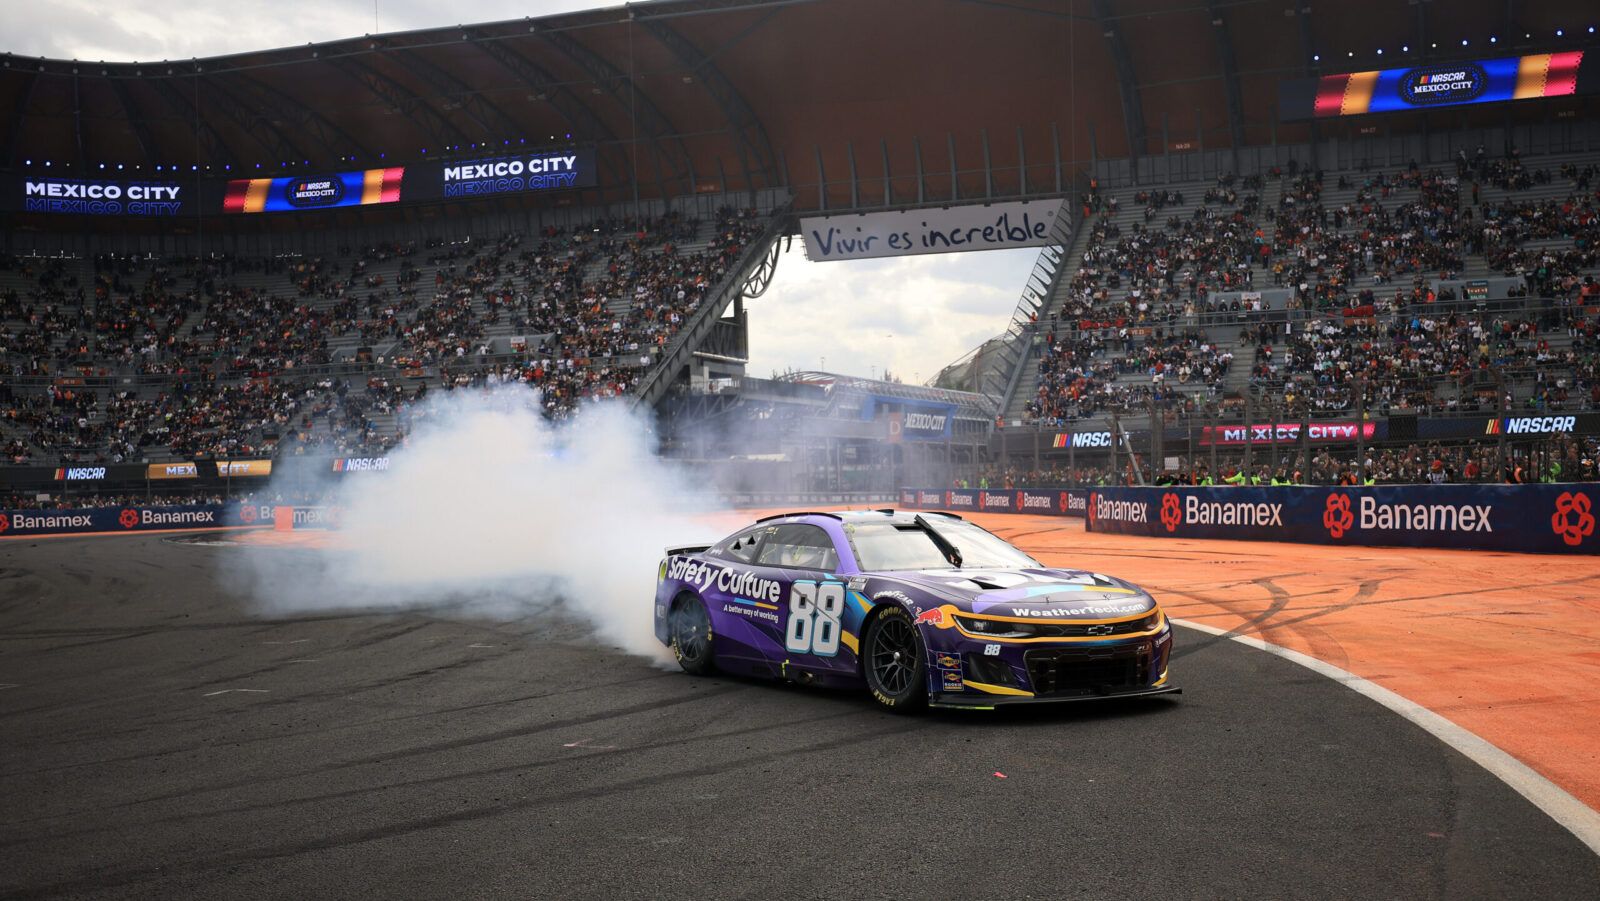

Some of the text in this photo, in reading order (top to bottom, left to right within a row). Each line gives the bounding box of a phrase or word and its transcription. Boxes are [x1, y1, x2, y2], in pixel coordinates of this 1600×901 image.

[1431, 71, 1466, 83] NASCAR
[1414, 81, 1472, 93] MEXICO CITY
[444, 160, 524, 181] MEXICO
[528, 156, 576, 173] CITY
[26, 182, 180, 200] MEXICO CITY
[307, 182, 330, 190] NASCAR
[444, 172, 577, 197] MEXICO CITY
[296, 190, 320, 198] MEXICO
[813, 213, 1047, 256] Vivir es increíble
[905, 413, 946, 430] MEXICO CITY
[1507, 416, 1575, 434] NASCAR
[1308, 426, 1354, 438] CITY
[220, 464, 250, 474] CITY
[346, 458, 390, 472] NASCAR
[67, 467, 105, 480] NASCAR
[951, 491, 972, 505] Banamex
[985, 493, 1009, 507] Banamex
[1023, 493, 1051, 508] Banamex
[1068, 493, 1086, 510] Bana
[142, 509, 214, 524] Banamex
[1097, 496, 1148, 523] Banamex
[1185, 496, 1283, 526] Banamex
[1360, 496, 1492, 532] Banamex
[13, 514, 92, 529] Banamex
[724, 604, 779, 624] A better way of working
[1012, 603, 1146, 617] WeatherTech.com
[787, 580, 846, 656] 88
[984, 645, 1001, 656] 88
